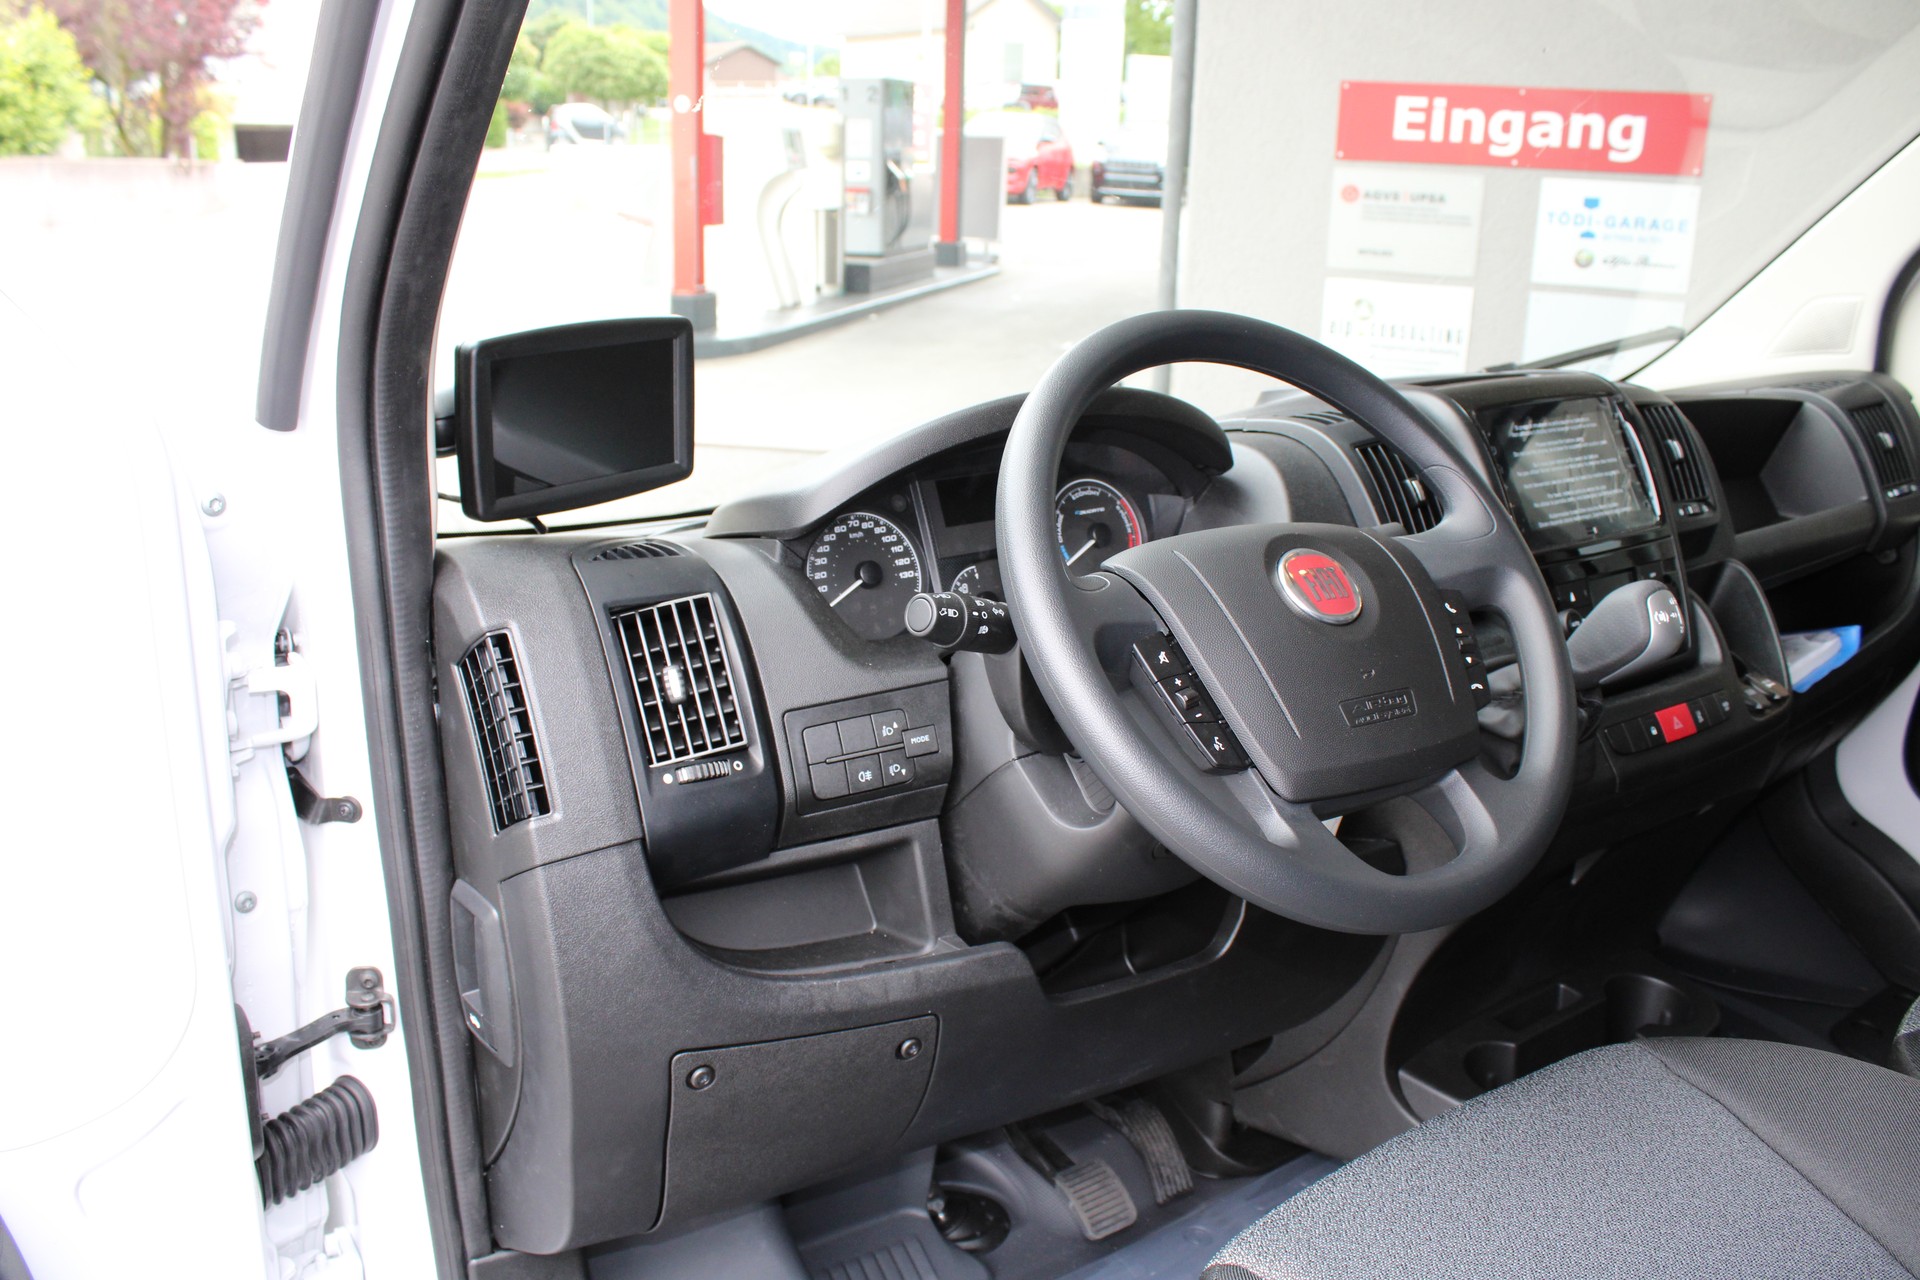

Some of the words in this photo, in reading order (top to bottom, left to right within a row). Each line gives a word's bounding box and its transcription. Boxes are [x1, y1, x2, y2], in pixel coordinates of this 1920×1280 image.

[1392, 95, 1648, 163] Eingang
[834, 525, 847, 533] 60
[861, 521, 874, 529] 80
[874, 526, 886, 534] 90
[823, 533, 836, 542] 50
[849, 531, 864, 539] km/h
[881, 534, 897, 543] 100
[817, 545, 830, 553] 40
[891, 545, 904, 553] 110
[814, 557, 827, 565] 30
[895, 557, 910, 566] 120
[814, 571, 827, 579] 20
[899, 570, 914, 579] 130
[1299, 566, 1349, 602] FIAT
[910, 734, 930, 744] MODE
